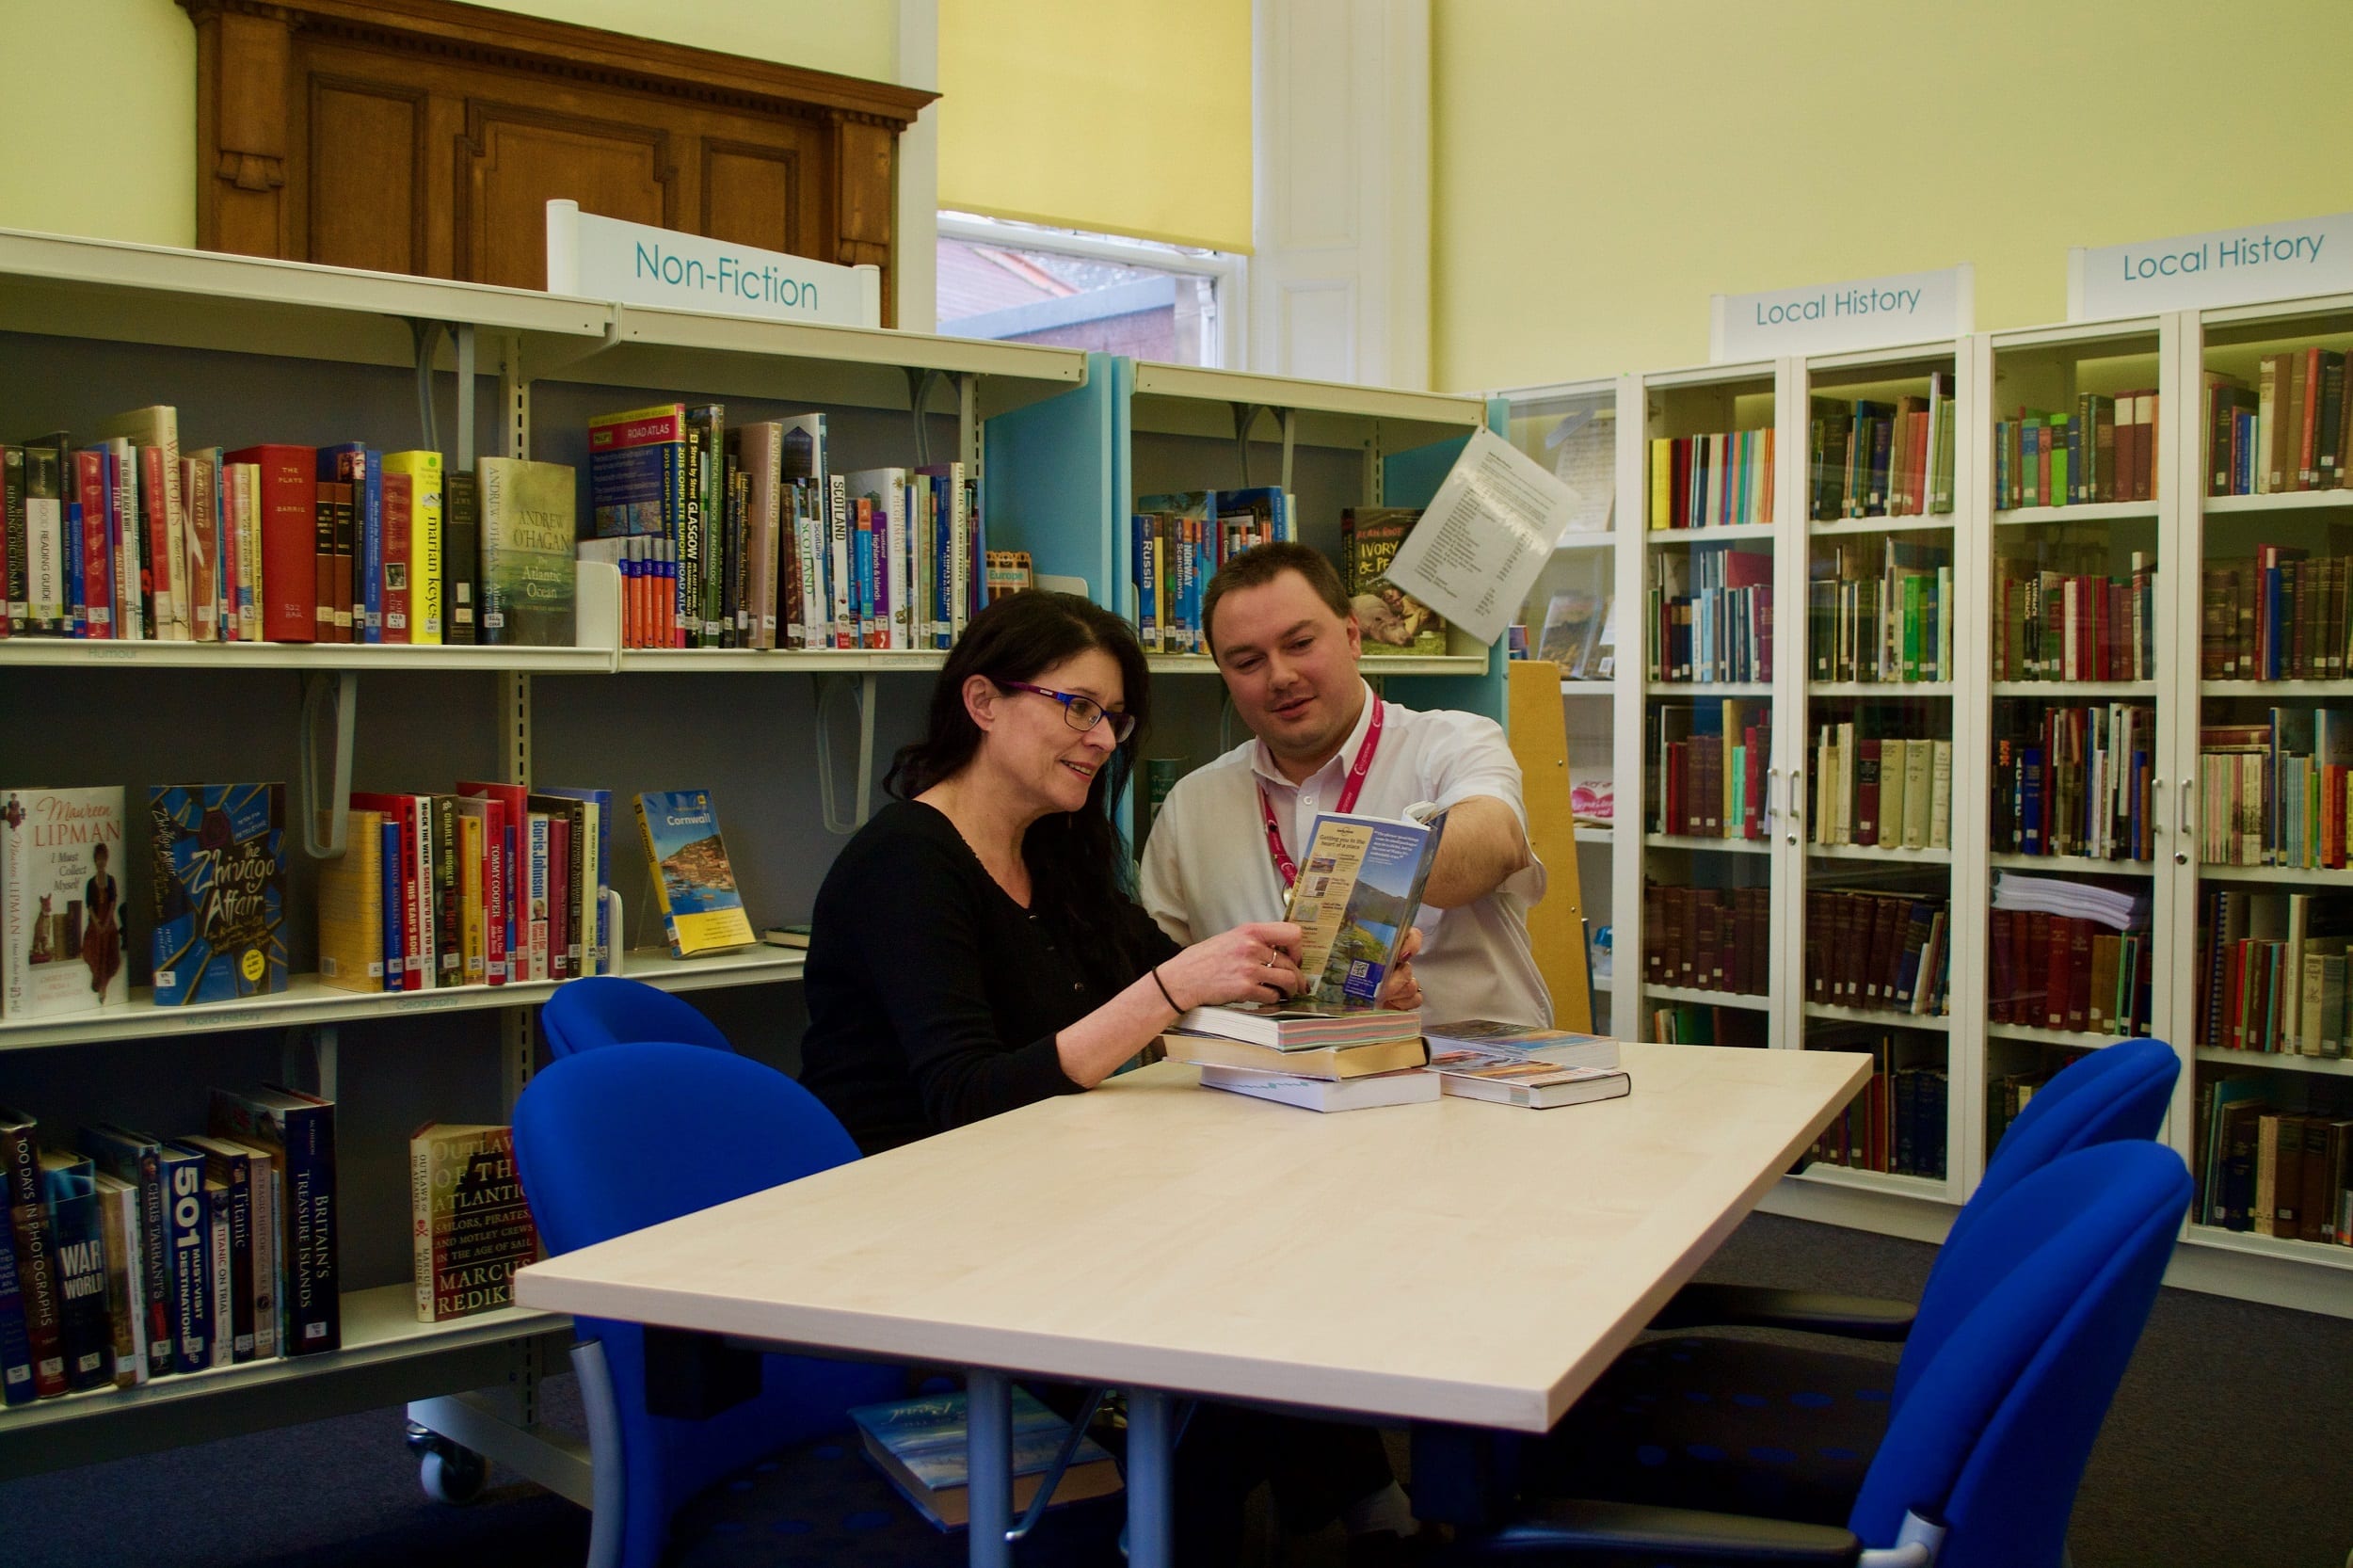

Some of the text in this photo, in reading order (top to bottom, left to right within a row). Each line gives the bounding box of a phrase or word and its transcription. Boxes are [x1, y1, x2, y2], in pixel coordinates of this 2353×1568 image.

[635, 240, 819, 311] Non-Fiction
[2124, 234, 2325, 281] Local History
[1757, 288, 1921, 326] Local History
[627, 426, 648, 439] ROAD
[648, 424, 670, 436] ATLAS
[771, 430, 780, 466] KEVIN
[689, 446, 697, 466] Street
[166, 438, 181, 527] WAR POETS
[488, 467, 501, 517] ANDREW
[689, 479, 697, 499] Street
[768, 469, 778, 528] McCLOUD'S
[519, 510, 564, 529] ANDREW
[833, 481, 846, 541] SCOTLAND
[7, 484, 20, 599] RHYMING DICTIONARY
[514, 528, 571, 552] O'HAGAN
[687, 502, 698, 560] GLASGOW
[813, 523, 823, 560] Scotland
[1361, 540, 1400, 558] IVORY
[40, 531, 51, 571] READING
[425, 516, 442, 620] marian keyes
[801, 522, 814, 595] SCOTLAND
[1143, 540, 1154, 588] Russia
[1183, 544, 1193, 587] NORWAY
[1358, 560, 1374, 574] &
[41, 574, 52, 602] GUIDE
[522, 566, 560, 583] Atlantic
[527, 582, 557, 599] Ocean
[872, 578, 881, 601] Islands
[989, 569, 1023, 582] Europe
[36, 796, 112, 822] Maureen
[666, 812, 712, 827] Cornwall
[34, 821, 121, 847] LIPMAN
[152, 808, 177, 876] Zhivago Affair
[444, 812, 453, 846] CHARLIE
[638, 822, 656, 864] Cornwall
[58, 851, 80, 863] Must
[243, 841, 261, 858] The
[445, 849, 455, 886] BROOKER
[532, 820, 547, 898] Boris Johnson
[54, 878, 81, 892] Myself
[59, 865, 88, 877] Collect
[191, 848, 276, 894] Zhivago
[408, 880, 416, 899] THIS
[491, 844, 501, 918] TOMMY COOPER
[9, 881, 22, 936] LIPMAN
[203, 888, 264, 939] Affair
[408, 902, 417, 933] YEAR'S
[396, 996, 459, 1011] Geography
[433, 1135, 514, 1161] OUTLA
[435, 1159, 514, 1189] OF TH
[174, 1165, 202, 1248] 501
[233, 1188, 249, 1248] Titanic
[435, 1209, 532, 1233] SAILORS, PIRATES,
[15, 1136, 54, 1327] 100 DAYS IN PHOTOGRAPHS
[147, 1182, 165, 1299] CHRIS TARRANT'S
[296, 1169, 312, 1308] TREASURE ISLANDS
[313, 1195, 331, 1278] BRITAIN'S
[435, 1224, 534, 1250] AND MOTLEY CREWS
[60, 1240, 102, 1278] WAR
[436, 1238, 533, 1264] IN THE AGE OF SAIL
[64, 1272, 104, 1300] WORLD
[192, 1248, 203, 1319] MUST-VISIT
[217, 1227, 229, 1316] TITANIC ON TRIAL
[439, 1257, 532, 1293] MARCUS
[179, 1251, 192, 1338] DESTINATION
[437, 1285, 515, 1316] REDIK
